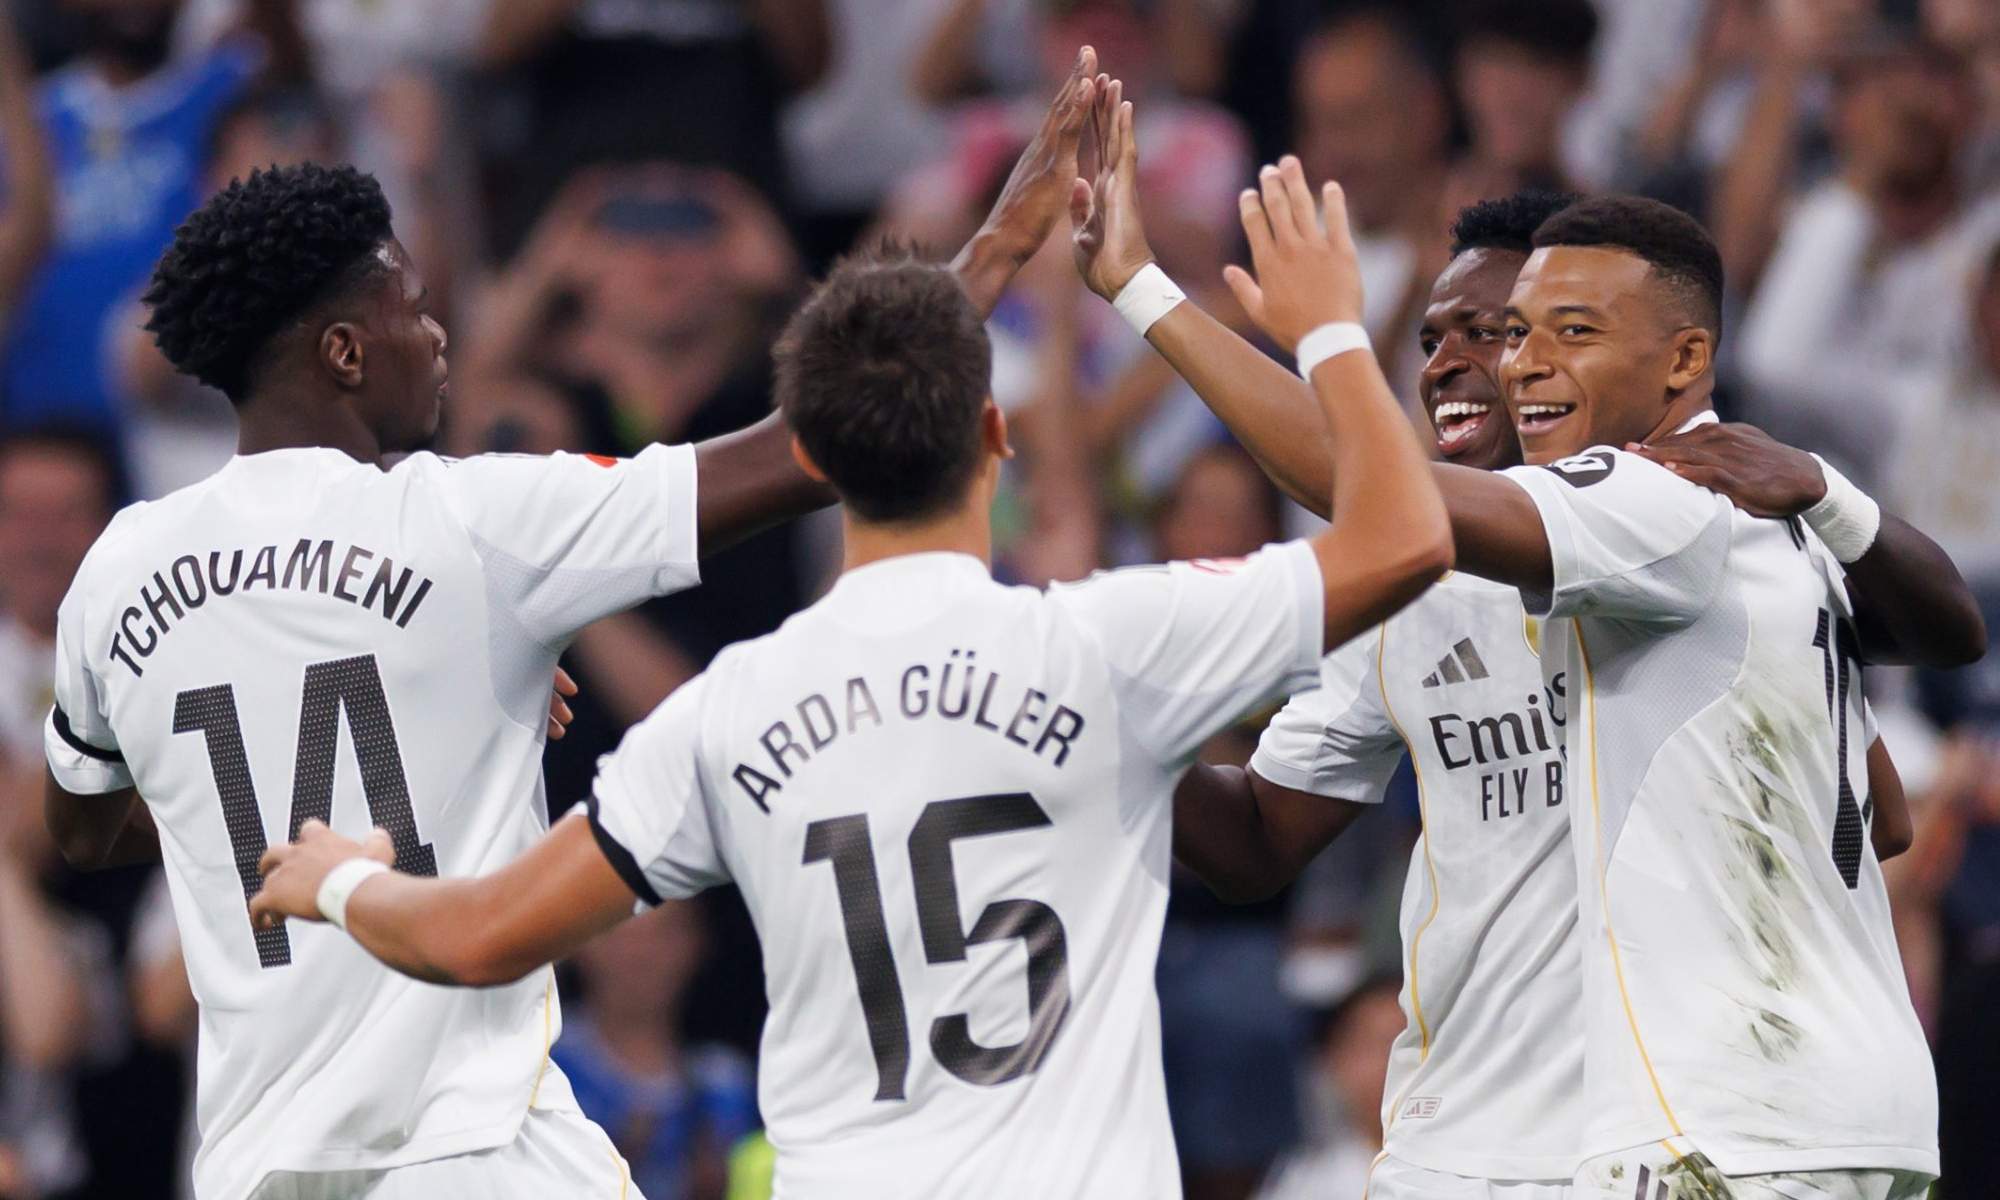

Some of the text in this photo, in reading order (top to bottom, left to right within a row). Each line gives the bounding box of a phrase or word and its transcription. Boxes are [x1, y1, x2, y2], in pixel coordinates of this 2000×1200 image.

[109, 537, 434, 678] TCHOUAMENI
[172, 653, 440, 969] 14
[732, 648, 1085, 815] ARDA GÜLER
[1481, 767, 1529, 822] FLY
[801, 791, 1072, 1103] 15
